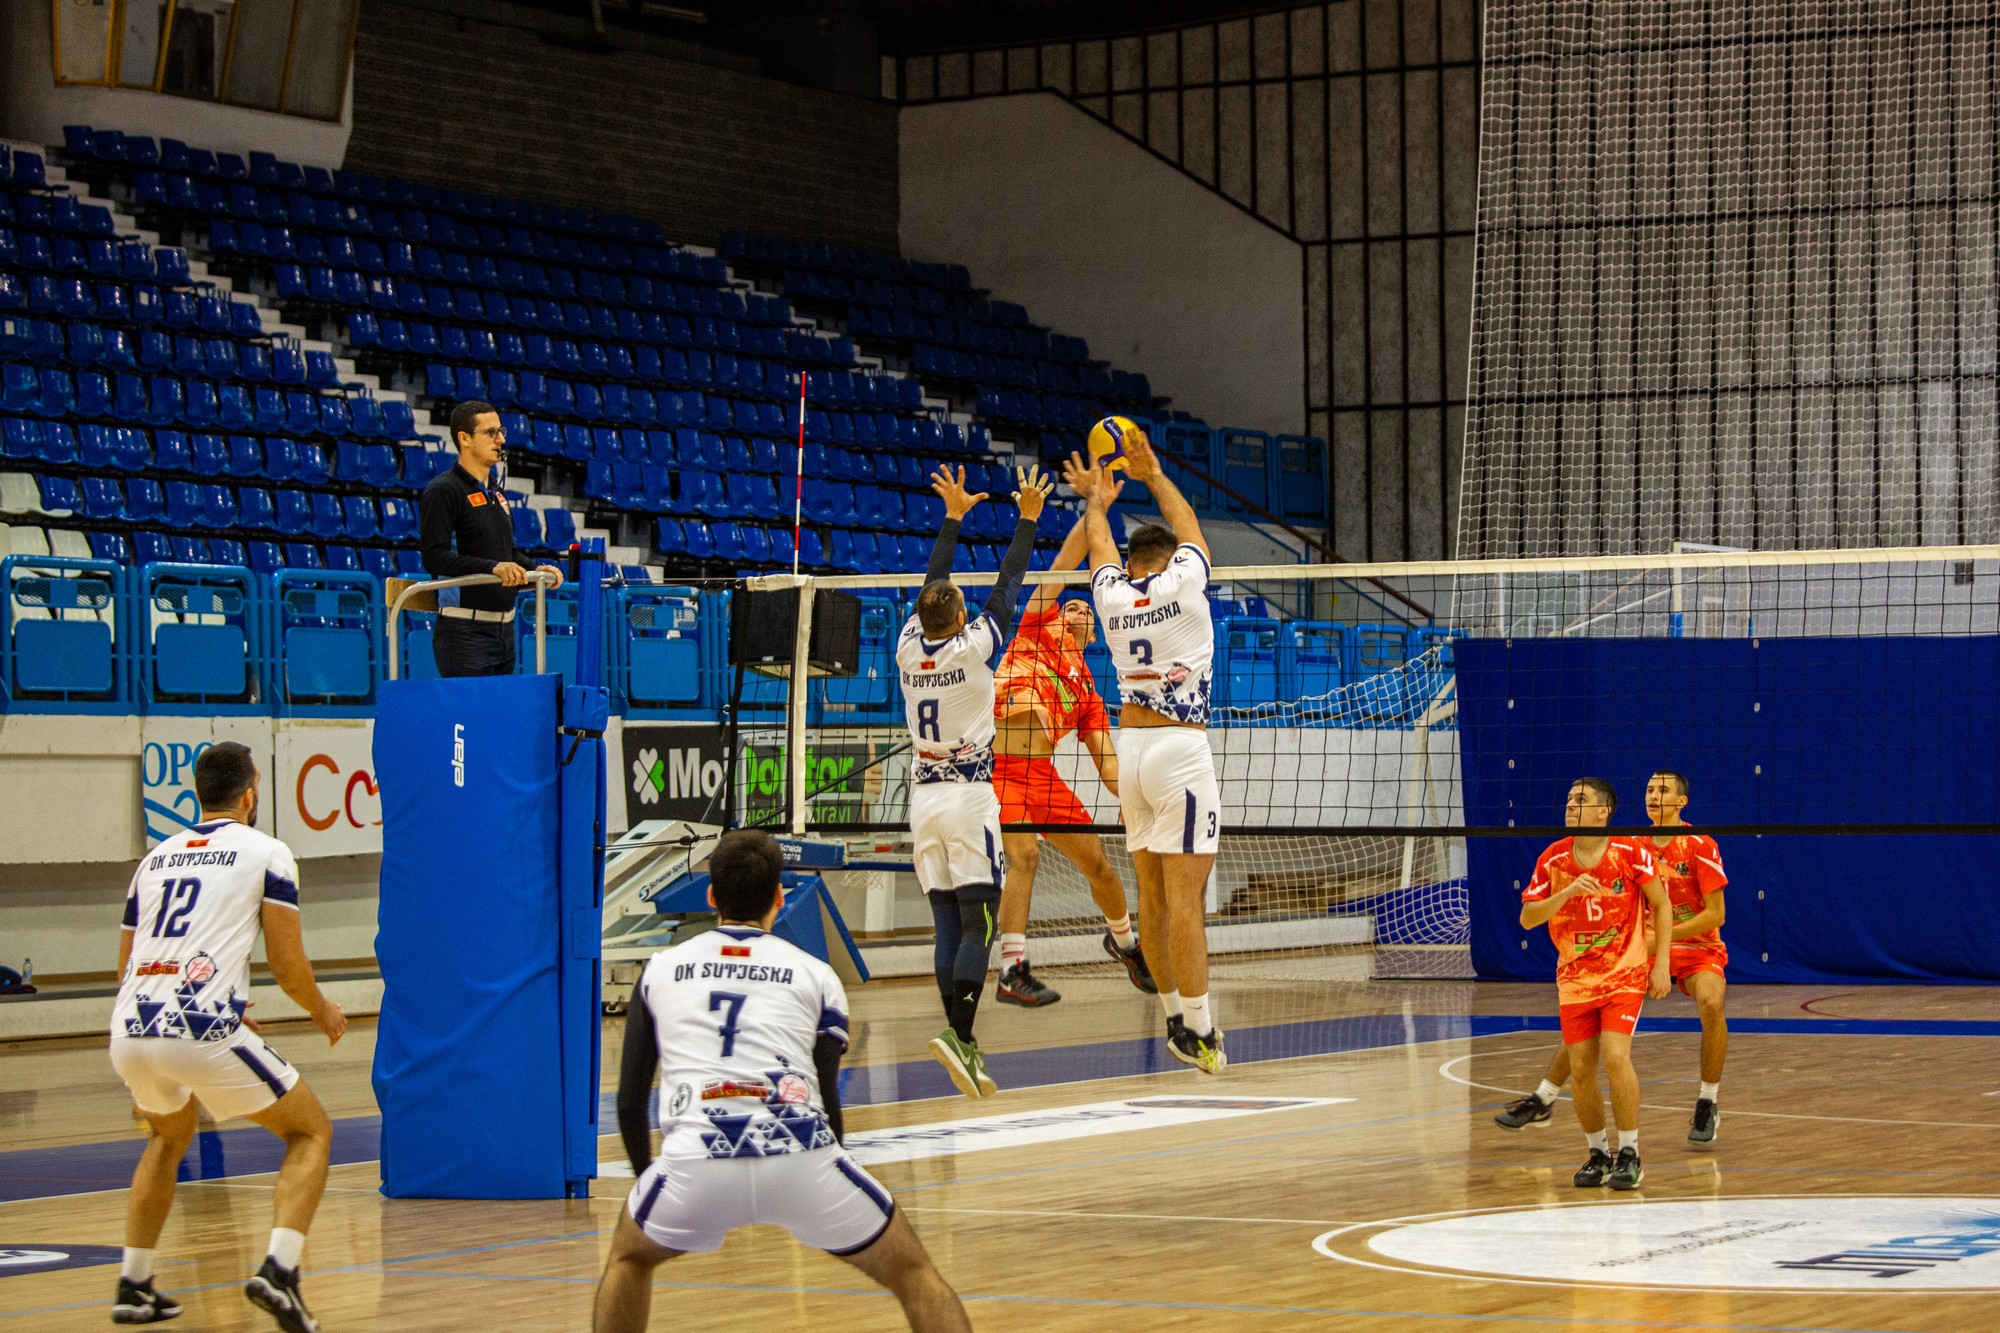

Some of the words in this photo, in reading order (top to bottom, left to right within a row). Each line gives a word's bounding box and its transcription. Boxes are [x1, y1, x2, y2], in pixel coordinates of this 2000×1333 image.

[1109, 615, 1120, 631] OK
[1122, 600, 1182, 630] SUTJESKA
[912, 668, 967, 688] SUTJESKA
[451, 723, 464, 787] elan
[1206, 811, 1216, 839] 3
[150, 854, 165, 871] OK
[168, 850, 238, 868] SUTJESKA
[151, 876, 202, 938] 12
[1585, 897, 1603, 921] 15
[674, 963, 697, 982] OK
[701, 962, 794, 985] SUTJESKA
[709, 990, 748, 1058] 7
